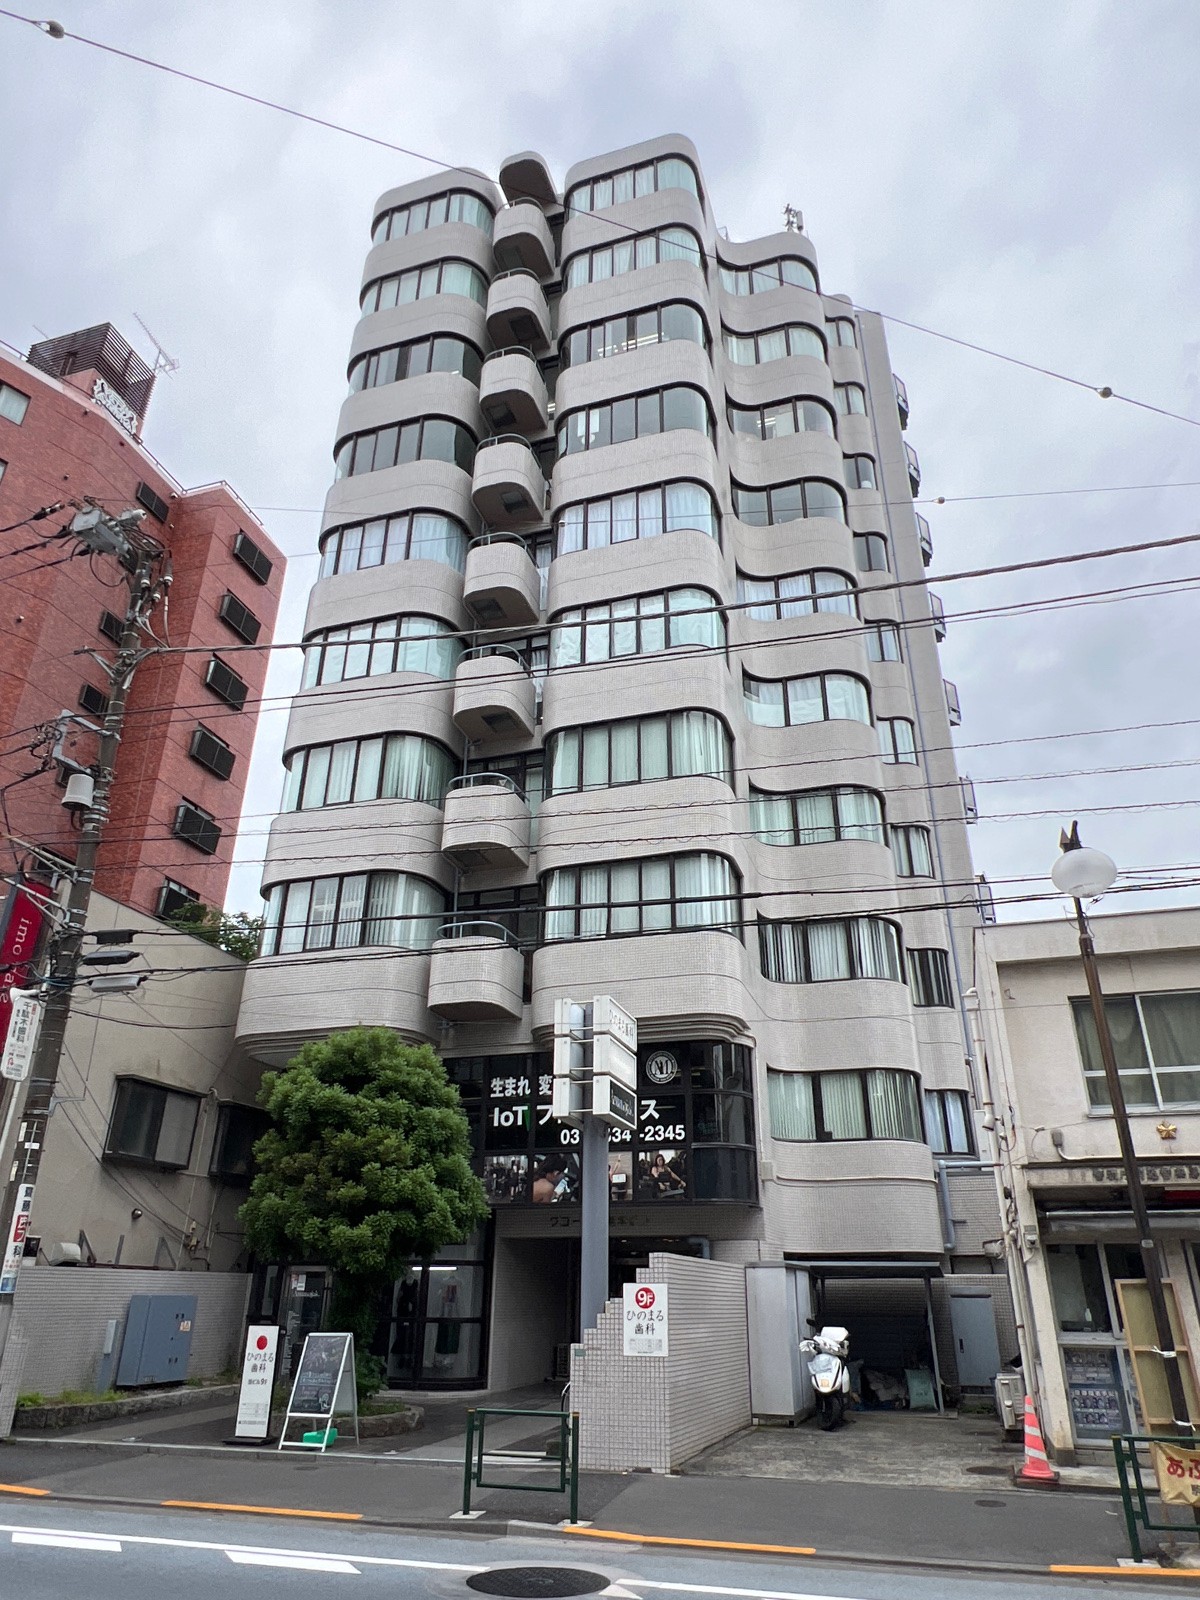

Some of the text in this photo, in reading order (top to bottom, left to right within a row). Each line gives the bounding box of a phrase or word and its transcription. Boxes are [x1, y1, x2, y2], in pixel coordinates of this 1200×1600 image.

[493, 1105, 529, 1127] IoT
[637, 1290, 654, 1306] 9F
[626, 1310, 664, 1322] ひのまる
[635, 1322, 656, 1336] 歯科
[246, 1351, 274, 1363] ひのまる
[251, 1363, 266, 1373] 歯科
